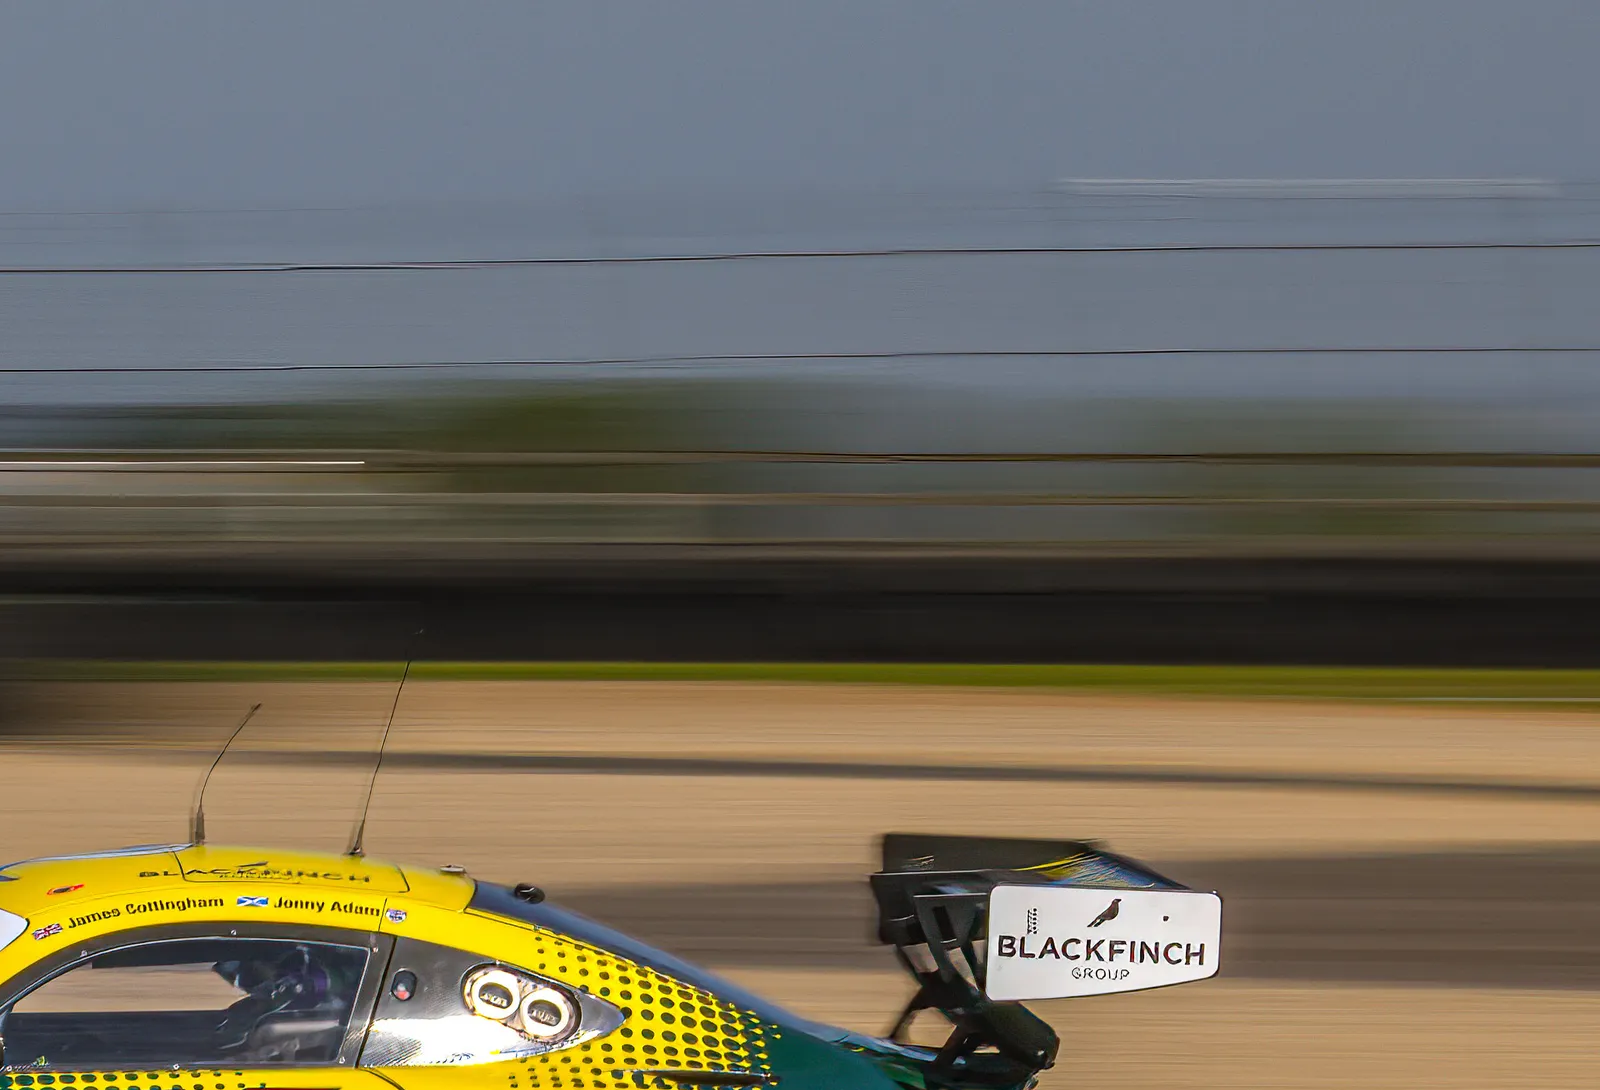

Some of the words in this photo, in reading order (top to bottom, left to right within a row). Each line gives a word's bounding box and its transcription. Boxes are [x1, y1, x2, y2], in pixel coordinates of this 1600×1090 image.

[68, 908, 120, 928] James
[125, 898, 224, 914] Cottingham
[274, 897, 324, 912] Jonny
[330, 902, 380, 917] Adam
[997, 935, 1205, 966] BLACKFINCH
[1071, 966, 1130, 980] GROUP
